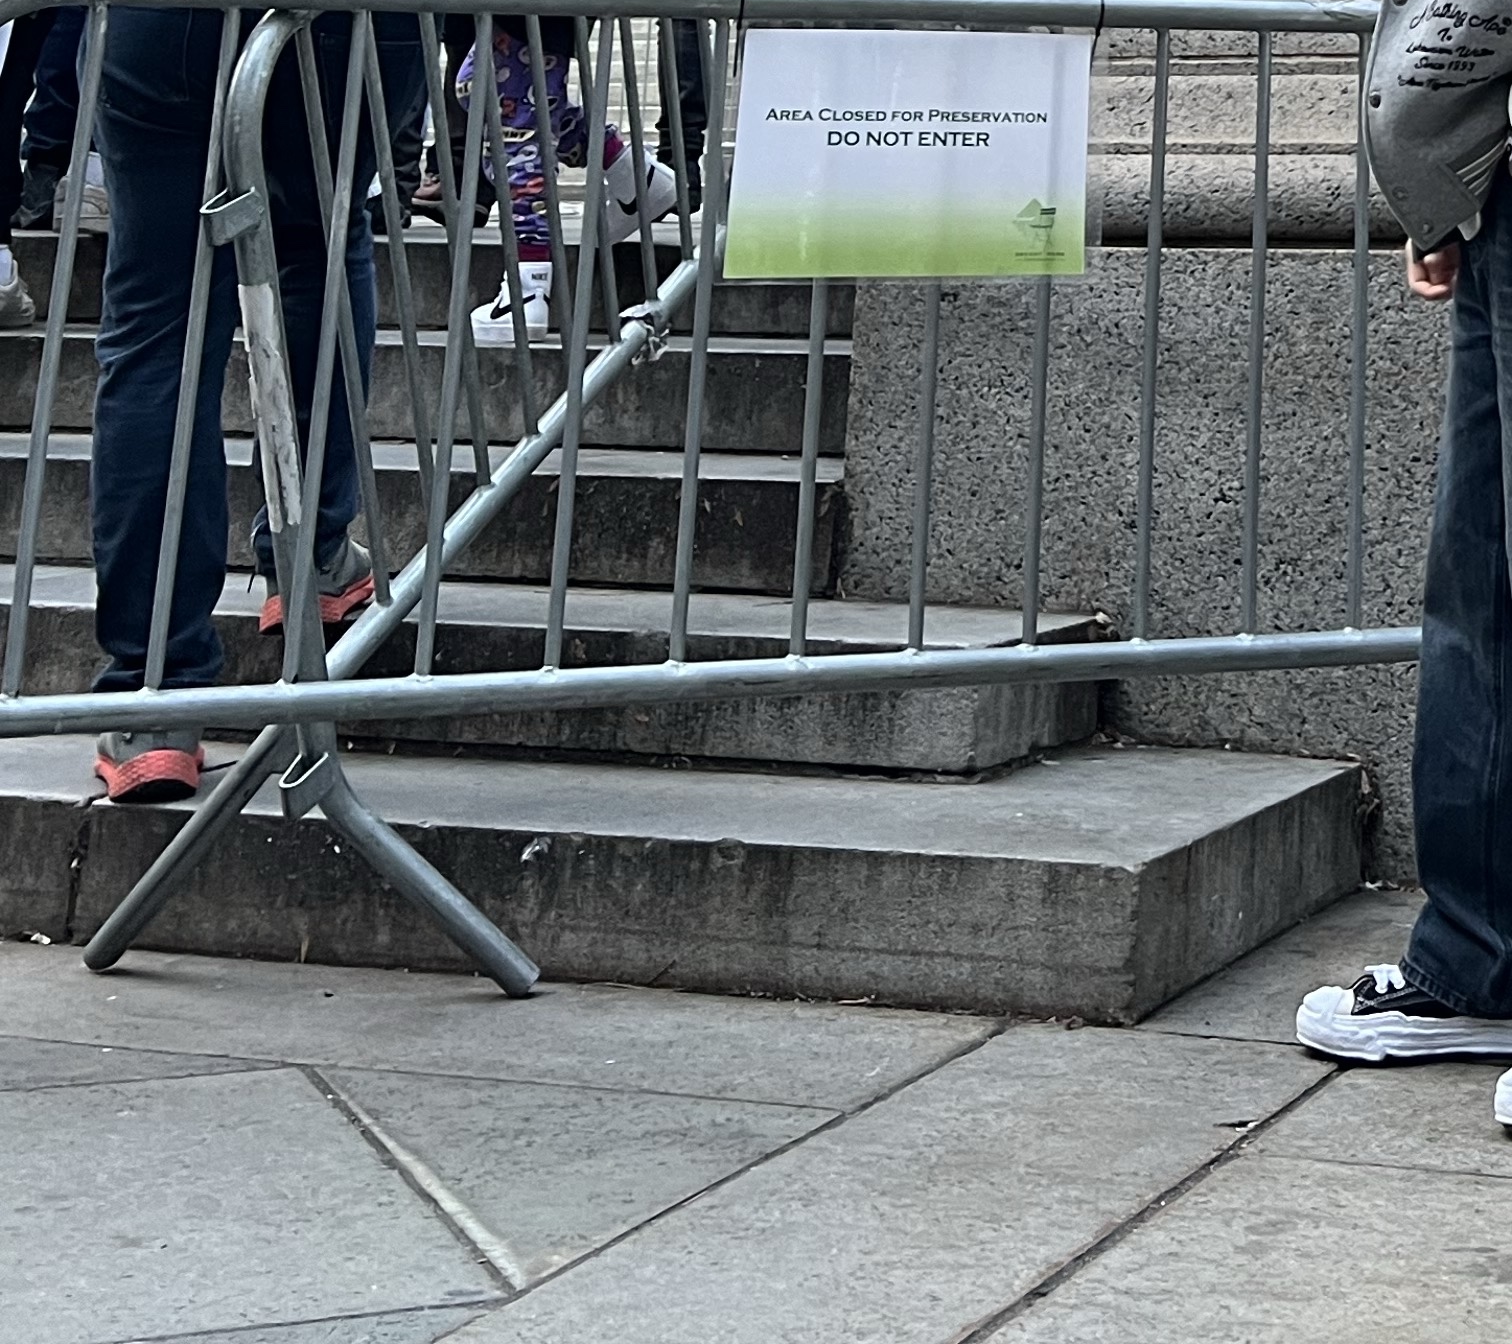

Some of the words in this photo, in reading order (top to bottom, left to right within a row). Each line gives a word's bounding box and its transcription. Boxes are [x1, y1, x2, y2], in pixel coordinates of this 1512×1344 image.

[827, 131, 860, 146] DO
[866, 131, 913, 146] NOT
[918, 131, 990, 147] ENTER
